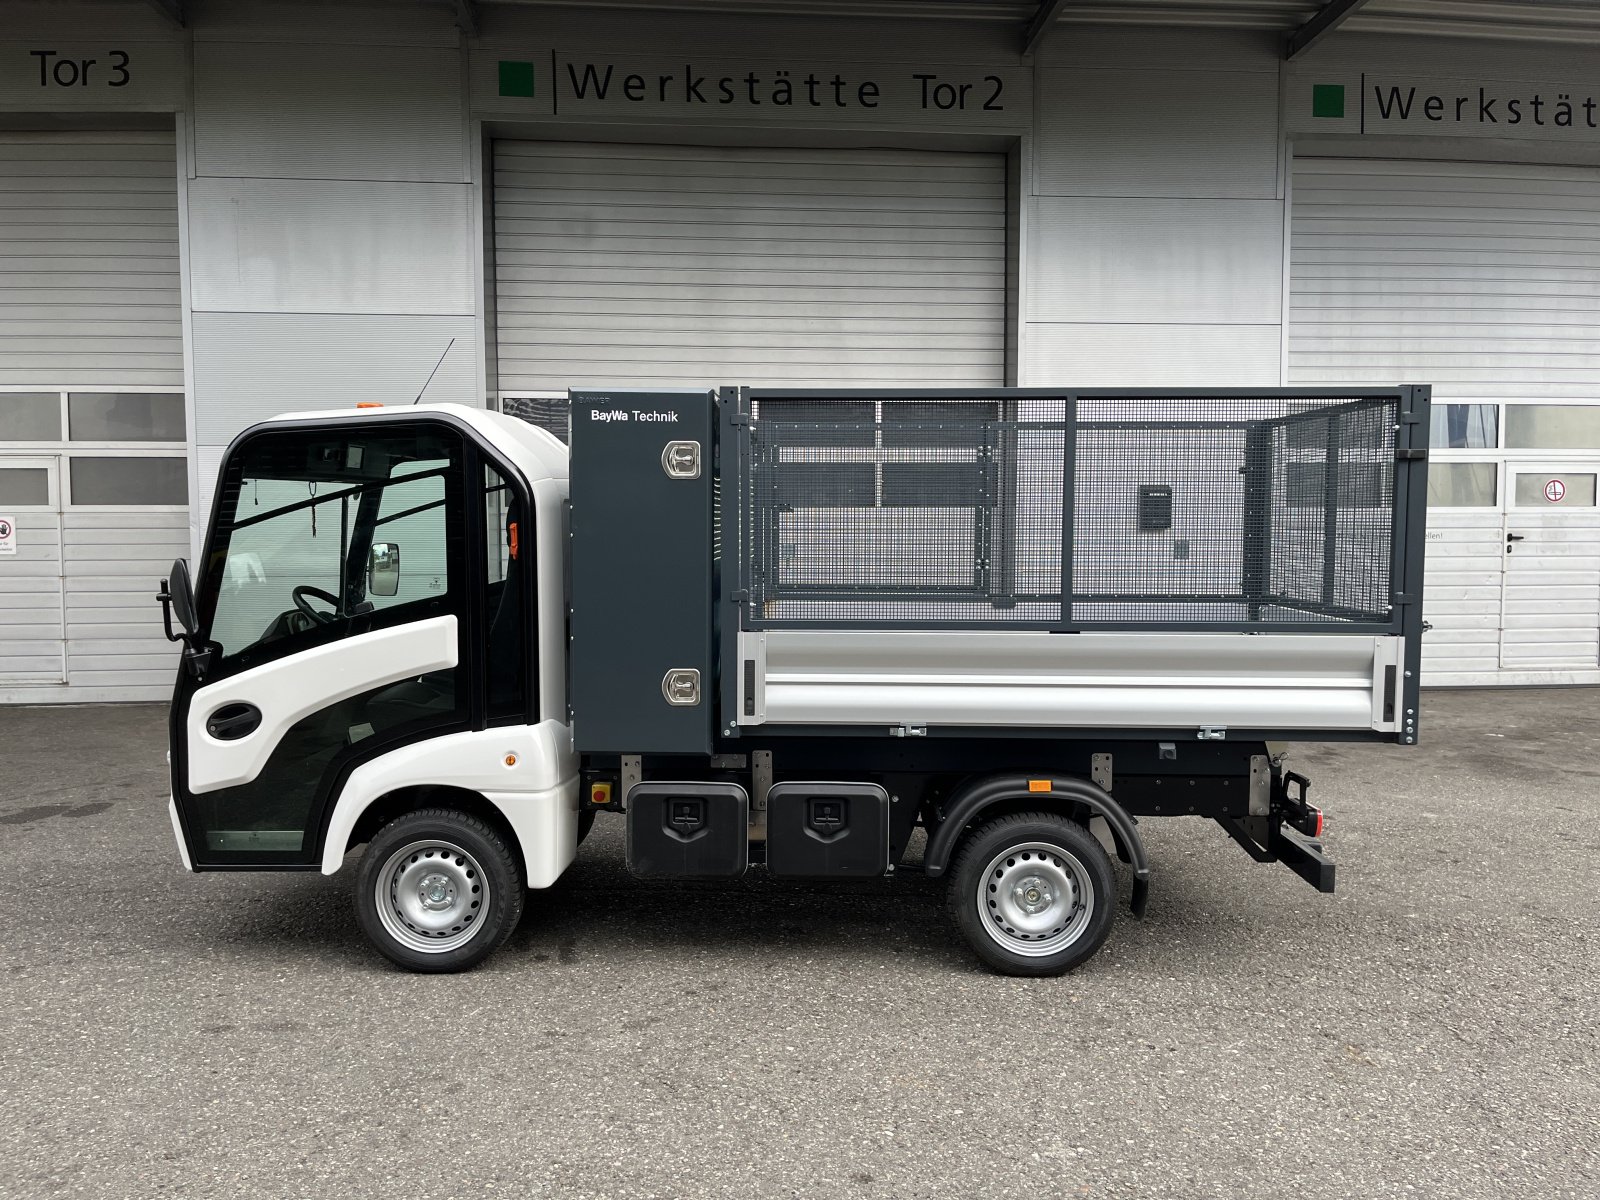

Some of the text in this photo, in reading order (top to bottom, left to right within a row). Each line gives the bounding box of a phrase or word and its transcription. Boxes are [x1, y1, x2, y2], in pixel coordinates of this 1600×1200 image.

[30, 50, 130, 87] Tor 3
[567, 63, 1004, 111] Werkstätte Tor 2
[591, 409, 679, 423] BayWa Technik
